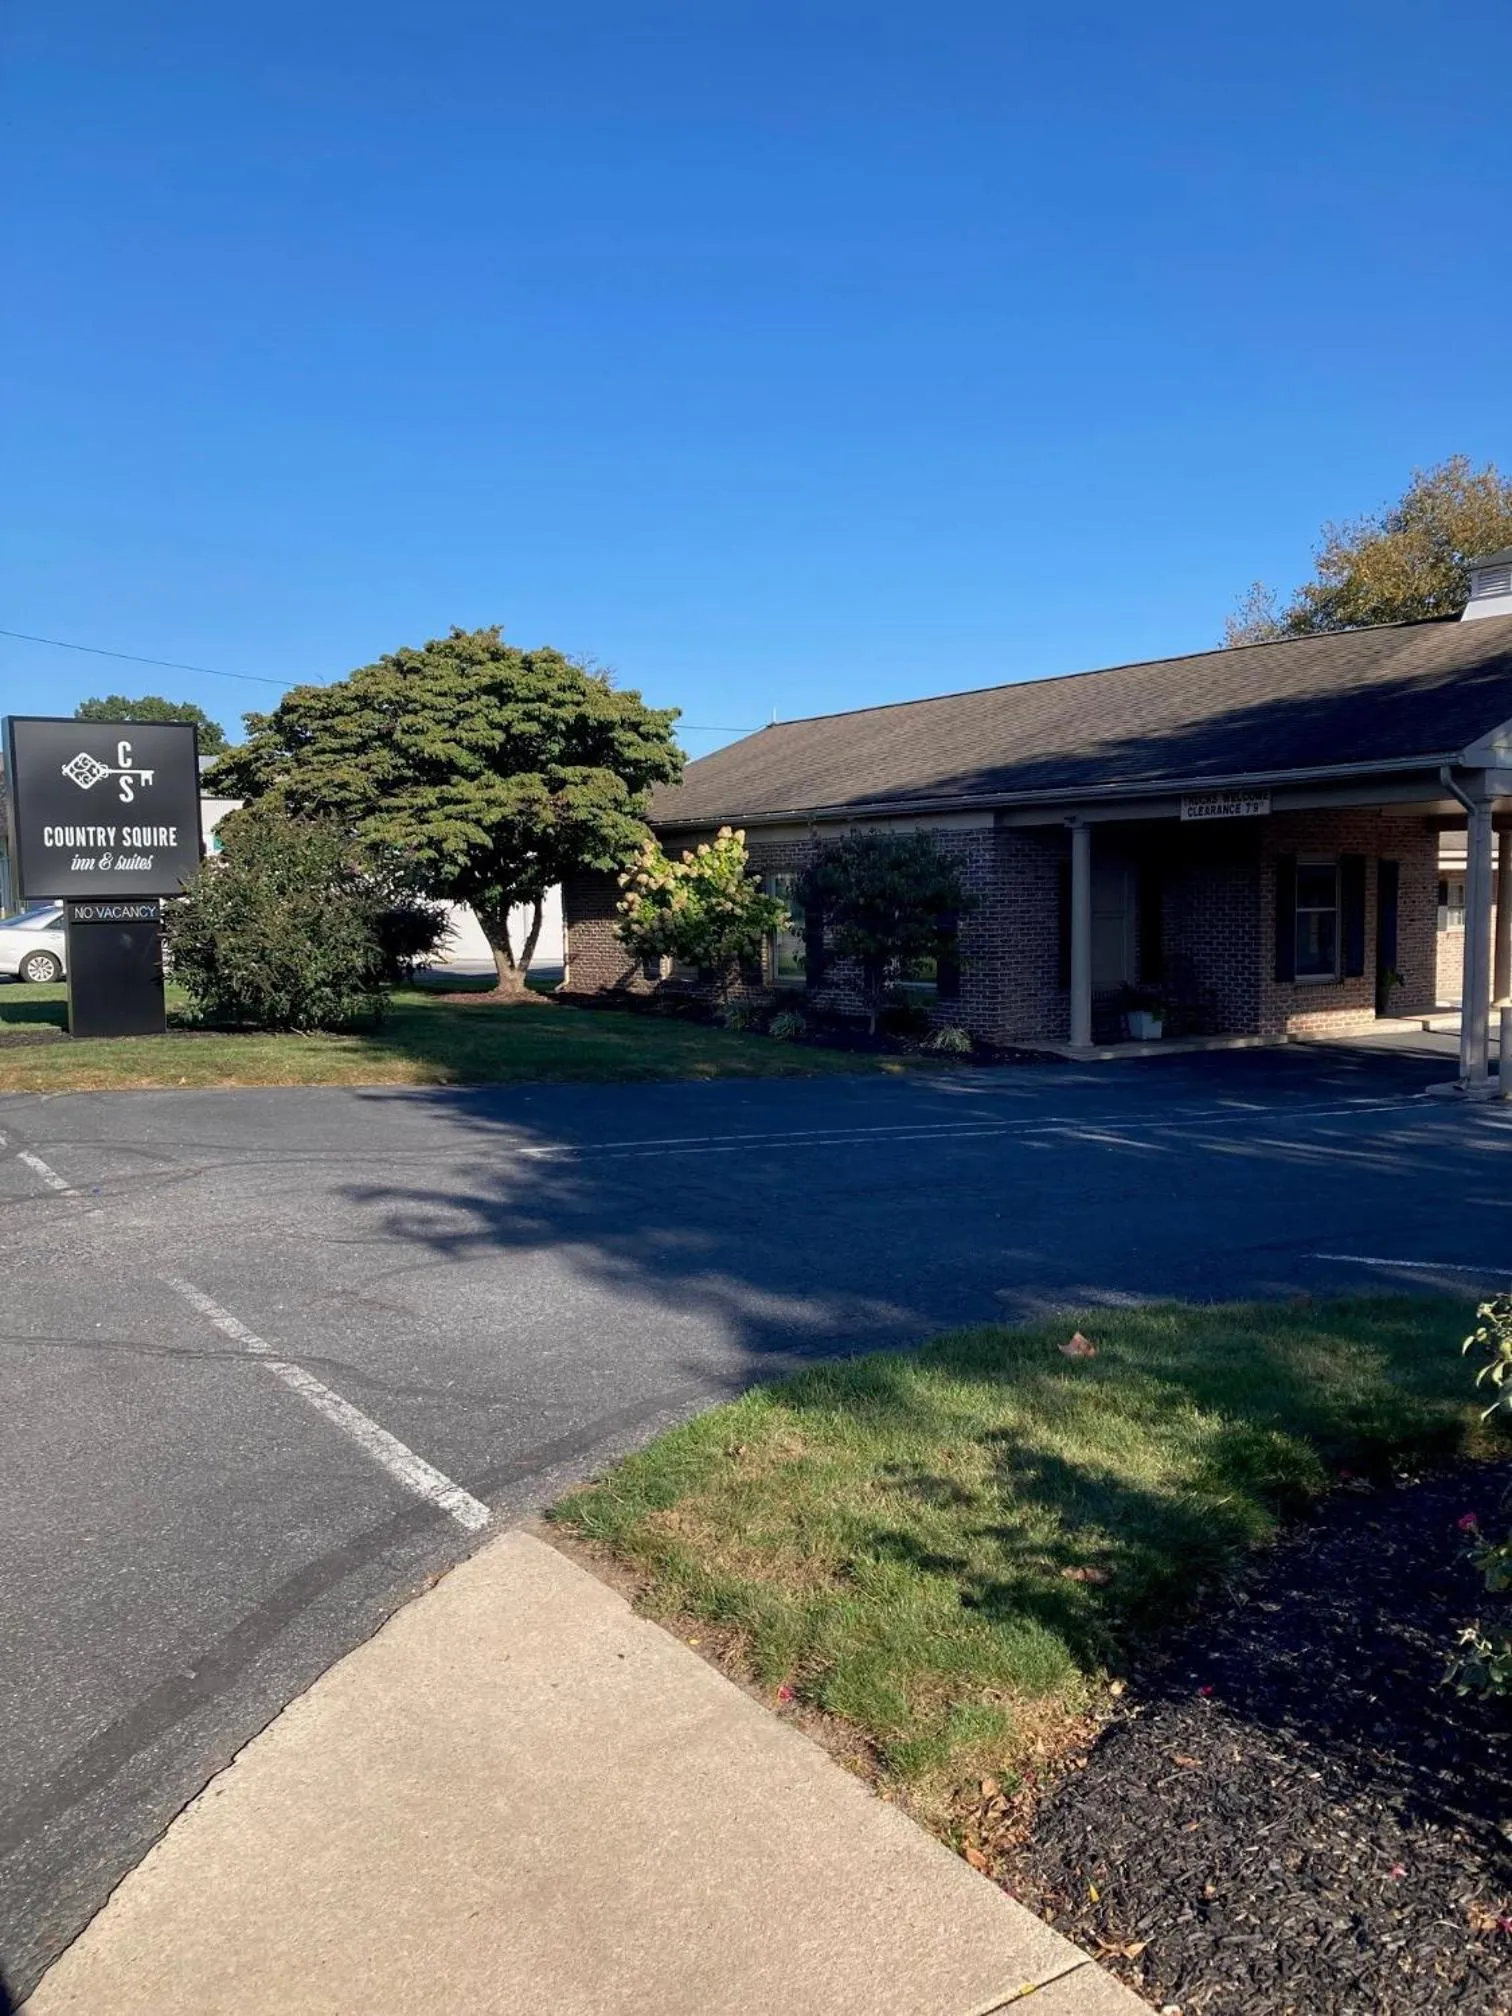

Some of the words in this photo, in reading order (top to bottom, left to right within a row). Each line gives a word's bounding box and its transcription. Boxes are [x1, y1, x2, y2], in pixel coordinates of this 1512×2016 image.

[118, 741, 132, 768] C
[119, 775, 134, 803] S
[1187, 803, 1241, 817] CLEARANCE
[44, 826, 116, 847] COUNTRY
[122, 826, 178, 848] SQUIRE
[70, 853, 95, 871] inn
[99, 852, 113, 871] &
[114, 854, 154, 871] suites
[75, 906, 93, 919] NO
[96, 905, 157, 919] VACANCY
